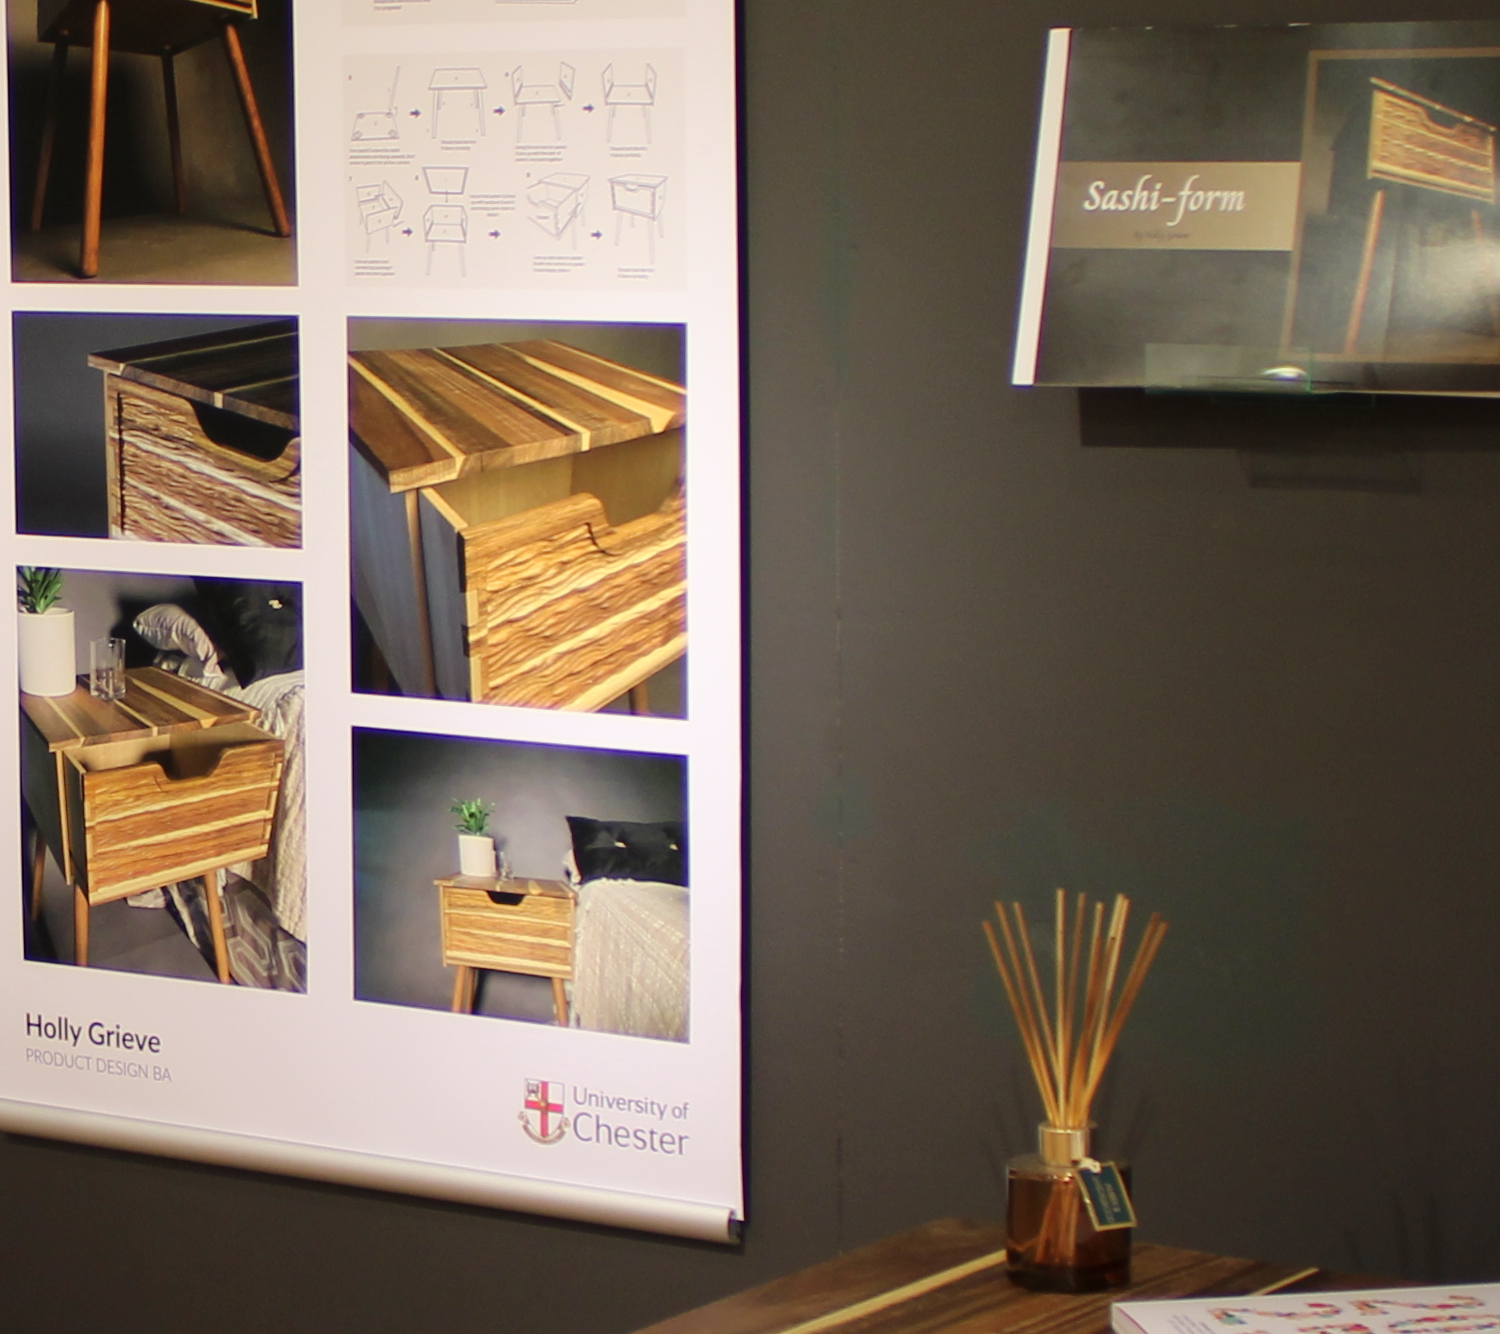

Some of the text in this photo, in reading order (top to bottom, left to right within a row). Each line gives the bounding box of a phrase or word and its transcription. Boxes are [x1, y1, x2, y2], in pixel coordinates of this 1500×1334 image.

[1083, 174, 1245, 226] Sashi-form
[26, 1012, 161, 1054] Holly Grieve
[26, 1048, 172, 1082] PRODUCT DESIGN BA
[573, 1086, 689, 1121] University of
[573, 1112, 689, 1156] Chester
